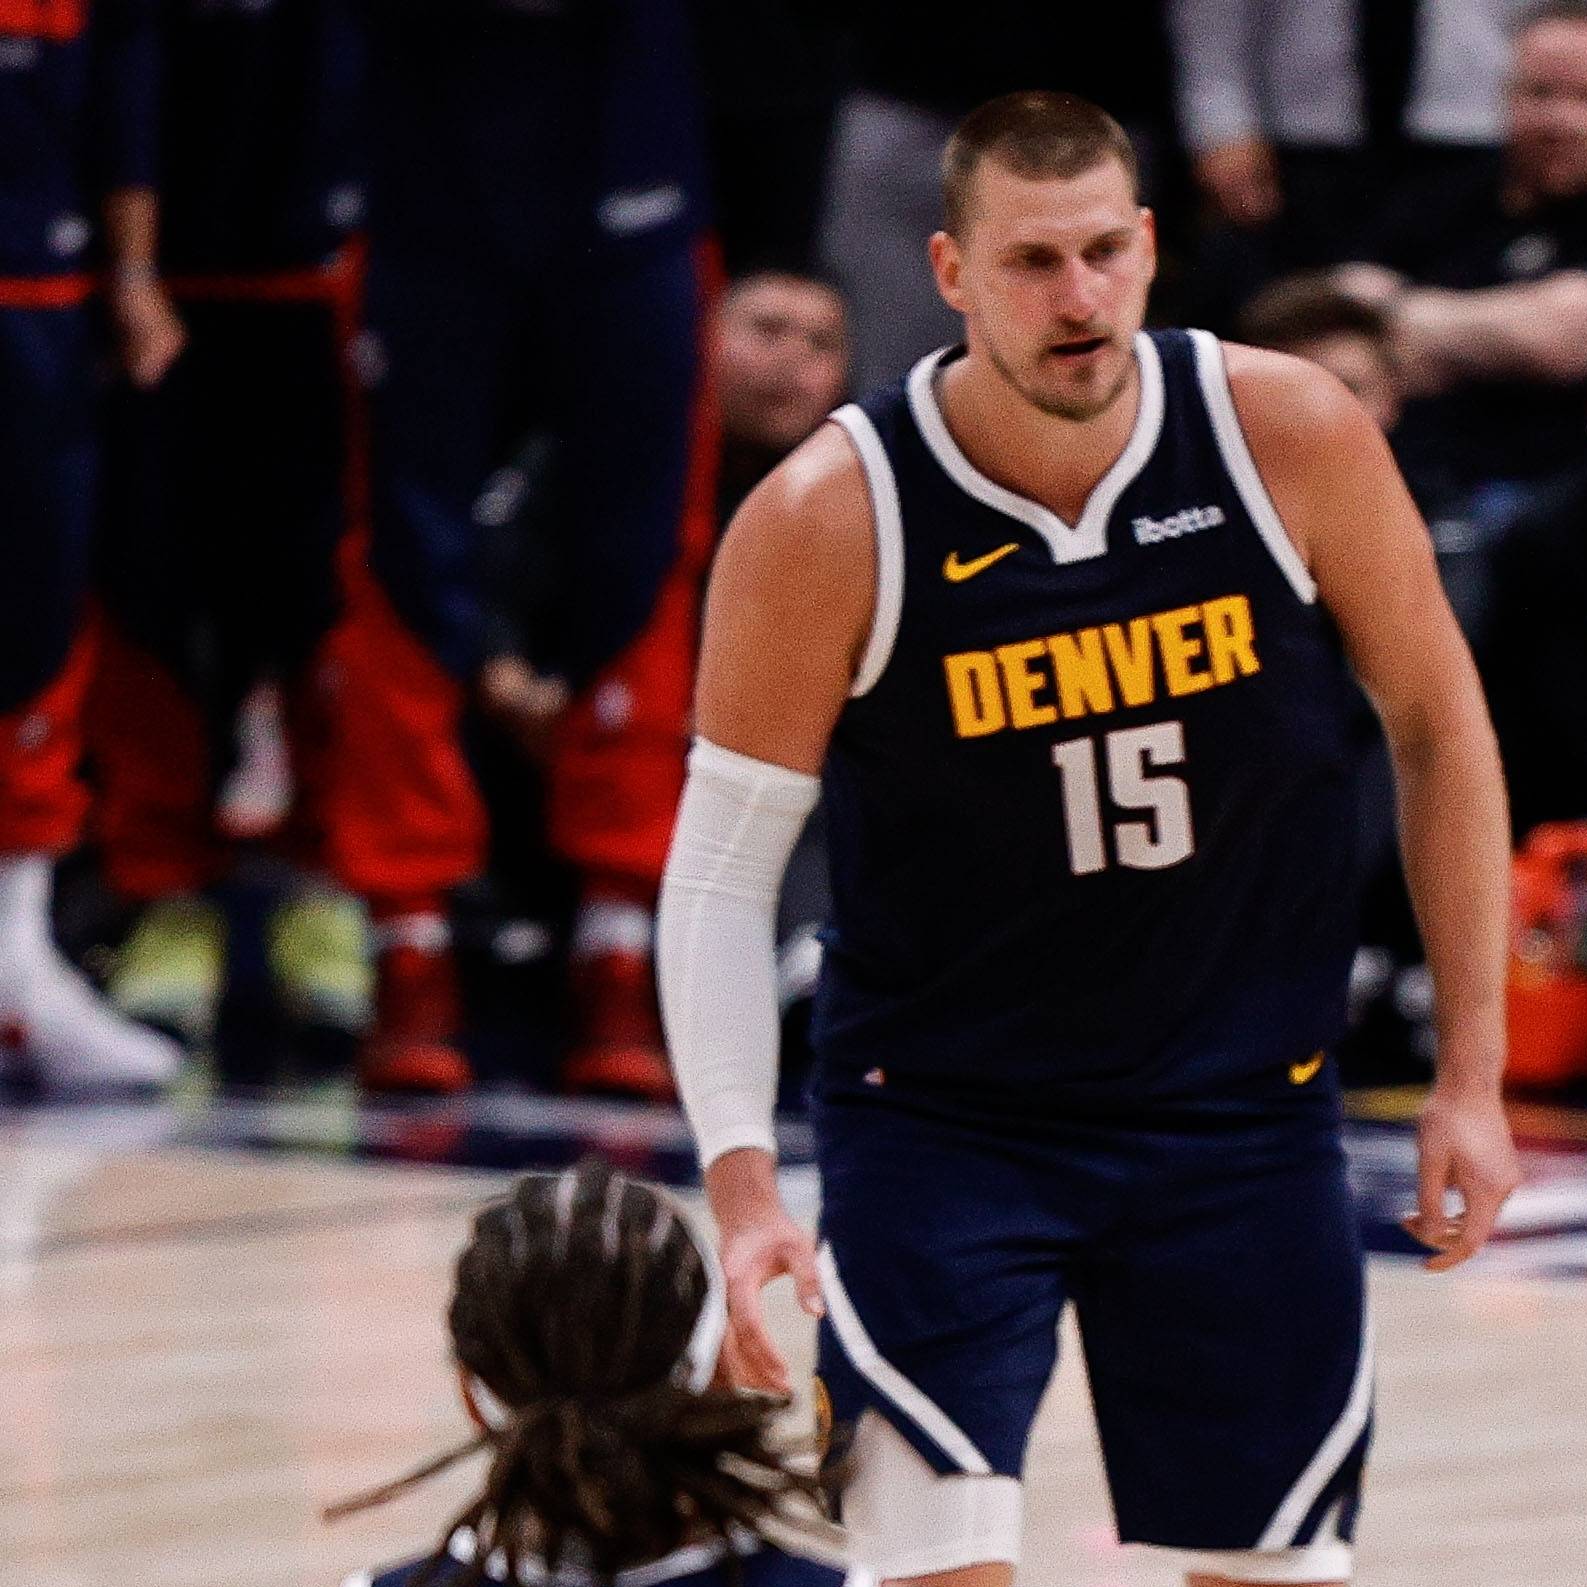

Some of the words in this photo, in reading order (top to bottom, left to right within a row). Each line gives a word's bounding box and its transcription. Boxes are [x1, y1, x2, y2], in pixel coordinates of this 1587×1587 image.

[1131, 505, 1226, 546] ibotta
[943, 594, 1261, 739] DENVER
[1051, 720, 1195, 876] 15
